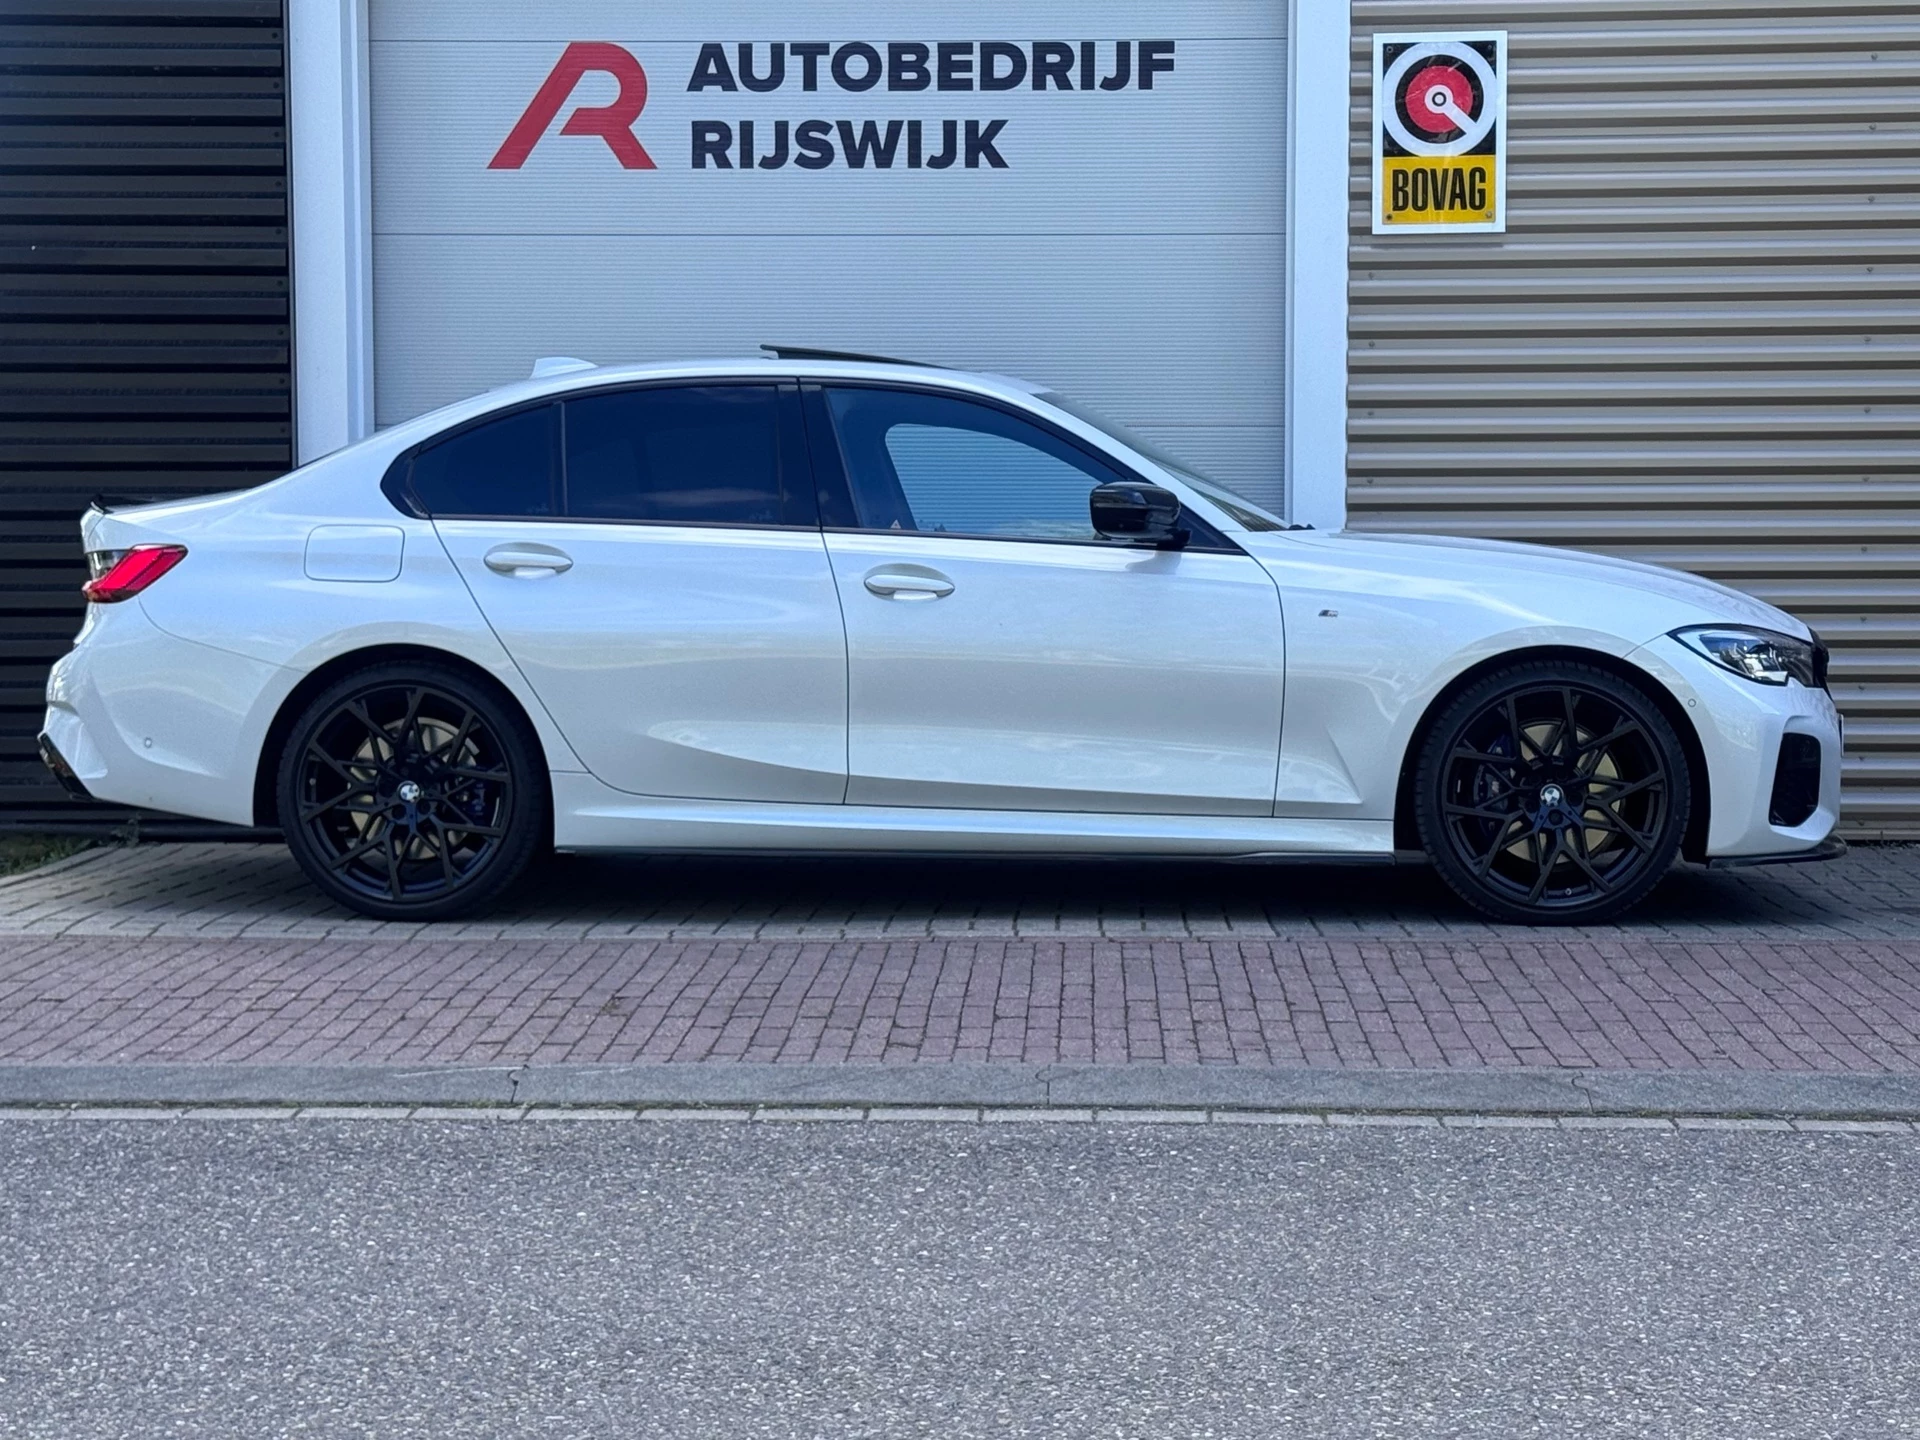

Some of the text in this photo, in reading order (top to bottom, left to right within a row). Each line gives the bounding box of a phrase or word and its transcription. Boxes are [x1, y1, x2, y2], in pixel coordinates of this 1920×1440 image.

[687, 41, 1175, 93] AUTOBEDRIJF
[691, 119, 1010, 170] RIJSWIJK
[1392, 166, 1487, 213] BOVAG
